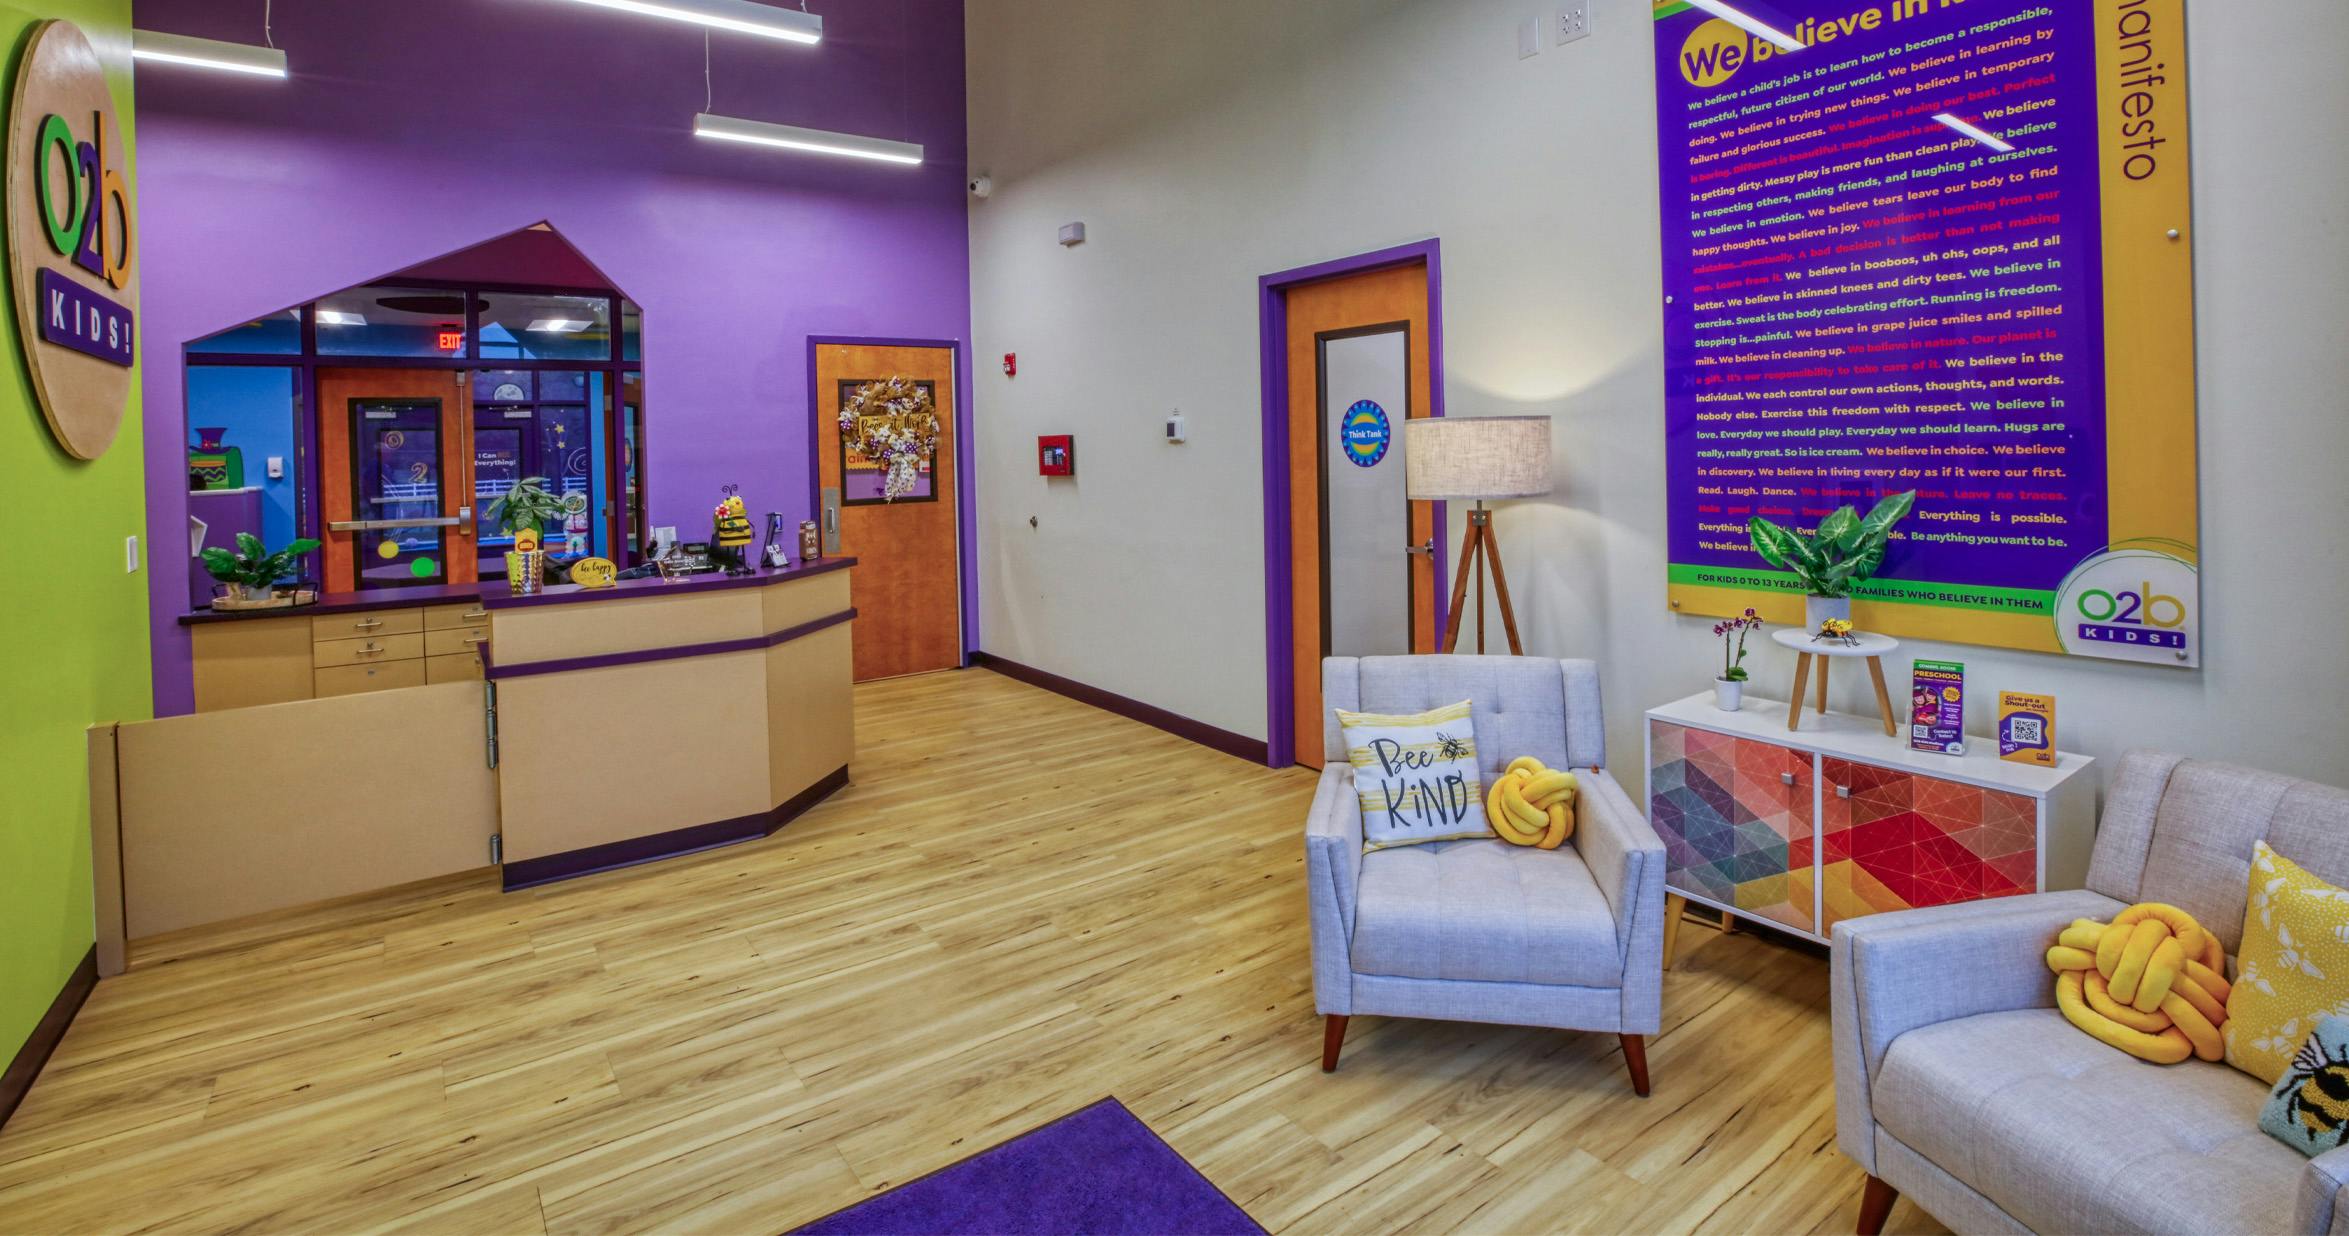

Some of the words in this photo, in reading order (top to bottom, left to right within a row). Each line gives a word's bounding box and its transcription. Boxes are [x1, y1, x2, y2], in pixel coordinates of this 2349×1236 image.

[1684, 42, 1741, 81] We
[1687, 101, 1703, 111] We
[1704, 91, 1738, 107] believe
[1748, 79, 1781, 95] child's
[1782, 73, 1801, 87] job
[1802, 69, 1813, 80] is
[1814, 67, 1827, 77] to
[1829, 58, 1859, 73] learn
[1861, 51, 1886, 64] how
[1887, 47, 1902, 57] to
[1904, 32, 1955, 53] become
[1969, 6, 2053, 35] responsible,
[1688, 108, 1739, 130] respectful,
[1740, 101, 1773, 116] future
[1774, 92, 1810, 107] citizen
[1812, 85, 1825, 97] of
[1827, 81, 1847, 93] our
[1848, 70, 1885, 87] world.
[1887, 66, 1907, 77] We
[1910, 53, 1956, 72] believe
[1959, 48, 1972, 60] in
[1975, 34, 2032, 55] learning
[2036, 28, 2055, 40] by
[1688, 135, 1718, 148] doing.
[1719, 129, 1735, 140] We
[1737, 120, 1773, 136] believe
[1775, 116, 1787, 126] in
[1788, 108, 1821, 123] trying
[1824, 102, 1848, 114] new
[1850, 92, 1890, 108] things.
[1892, 86, 1912, 97] We
[1915, 74, 1961, 92] believe
[1964, 69, 1977, 80] in
[1981, 51, 2055, 76] temporary
[1690, 210, 1701, 220] in
[1702, 201, 1754, 218] respecting
[1755, 195, 1792, 208] others,
[1794, 185, 1834, 201] making
[1837, 176, 1882, 193] friends,
[1884, 170, 1908, 184] and
[1911, 161, 1965, 179] laughing
[1969, 156, 1984, 168] at
[1987, 144, 2058, 164] ourselves.
[1691, 228, 1707, 238] We
[1709, 223, 1744, 235] believe
[1746, 219, 1756, 229] in
[1759, 211, 1805, 226] emotion.
[1807, 207, 1825, 218] We
[1828, 200, 1869, 214] believe
[1872, 194, 1904, 207] tears
[1907, 188, 1940, 201] leave
[1943, 183, 1967, 194] our
[1970, 175, 2004, 190] body
[2008, 172, 2025, 183] to
[2029, 164, 2059, 179] find
[1693, 300, 1726, 312] better.
[1726, 298, 1743, 307] We
[1744, 293, 1781, 305] believe
[1782, 290, 1794, 301] in
[1795, 284, 1838, 299] skinned
[1840, 282, 1874, 294] knees
[1876, 277, 1899, 290] and
[1902, 274, 1932, 286] dirty
[1934, 271, 1967, 282] tees.
[1968, 267, 1990, 278] We
[1993, 261, 2044, 275] believe
[2047, 260, 2061, 269] in
[51, 288, 131, 353] KIDS!
[1693, 317, 1735, 330] exercise.
[1735, 313, 1766, 325] Sweat
[1766, 311, 1776, 322] is
[1776, 311, 1795, 321] the
[1795, 307, 1823, 319] body
[1823, 300, 1888, 316] celebrating
[1889, 296, 1929, 309] effort.
[1930, 290, 1983, 305] Running
[1984, 287, 1996, 299] is
[1997, 283, 2062, 297] freedom.
[439, 333, 462, 350] EXIT
[1695, 391, 1745, 403] individual.
[1744, 391, 1762, 400] We
[1762, 389, 1787, 399] each
[1788, 386, 1827, 398] control
[1828, 387, 1849, 396] our
[1849, 386, 1874, 395] own
[1875, 381, 1923, 394] actions,
[1924, 378, 1987, 392] thoughts,
[1989, 376, 2015, 388] and
[2017, 374, 2065, 386] words.
[1348, 430, 1366, 438] Think
[1367, 429, 1382, 438] Tank
[1696, 466, 1707, 476] in
[1708, 466, 1756, 478] discovery.
[1757, 467, 1775, 476] We
[1776, 466, 1814, 477] believe
[1816, 466, 1828, 477] in
[1829, 466, 1861, 479] living
[1863, 468, 1896, 479] every
[1898, 467, 1921, 479] day
[1923, 468, 1939, 477] as
[1941, 466, 1952, 477] if
[1954, 466, 1965, 477] it
[1967, 469, 2001, 477] were
[2004, 469, 2029, 477] our
[2031, 466, 2067, 478] first.
[1918, 509, 1981, 524] Everything
[1990, 510, 2001, 522] is
[2010, 512, 2068, 525] possible.
[1911, 531, 1926, 541] Be
[1925, 532, 1976, 545] anything
[1976, 535, 1999, 546] you
[1999, 535, 2031, 546] want
[2030, 535, 2046, 546] to
[2047, 536, 2068, 547] be.
[1697, 573, 1715, 582] FOR
[1716, 574, 1738, 584] KIDS
[1747, 577, 1760, 586] TO
[1762, 579, 1772, 587] 13
[1774, 579, 1805, 590] YEARS
[1855, 586, 1904, 598] FAMILIES
[1906, 589, 1936, 600] WHO
[1939, 593, 1988, 605] BELIEVE
[1990, 596, 2004, 606] IN
[2006, 598, 2043, 609] THEM
[2085, 628, 2178, 646] KIDS!
[1914, 670, 1963, 681] PRESCHOOL
[1368, 738, 1433, 777] Bee
